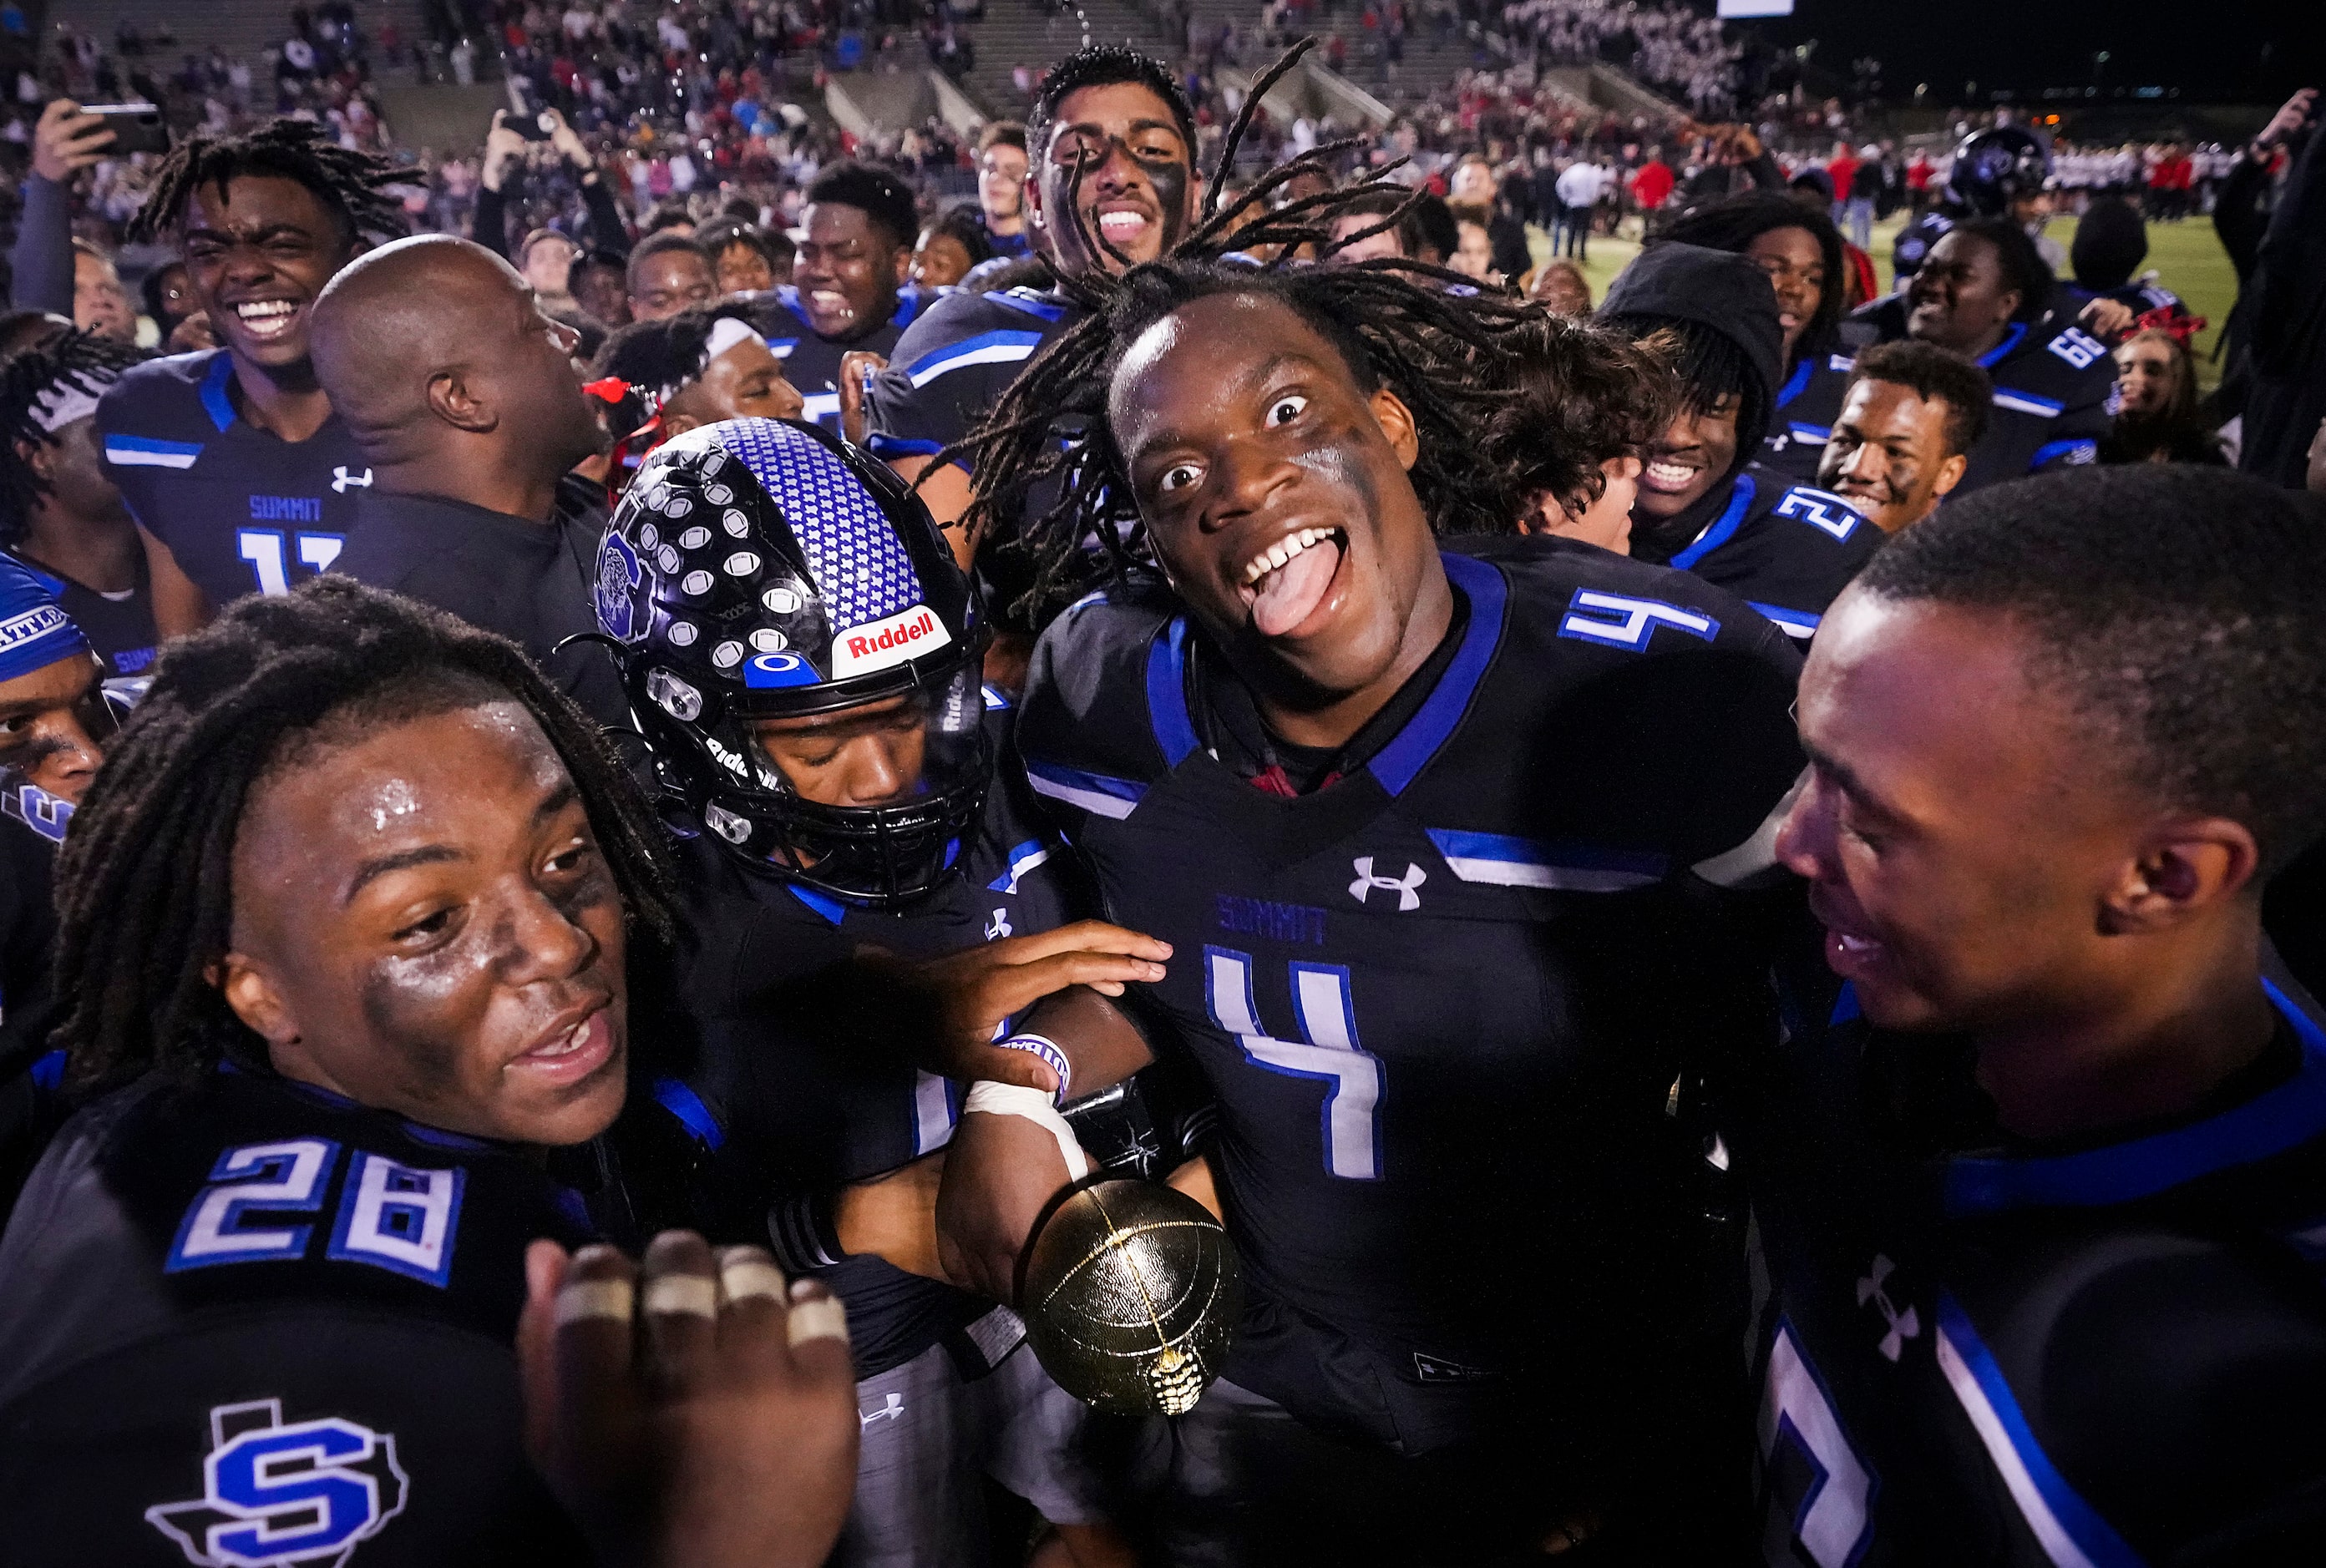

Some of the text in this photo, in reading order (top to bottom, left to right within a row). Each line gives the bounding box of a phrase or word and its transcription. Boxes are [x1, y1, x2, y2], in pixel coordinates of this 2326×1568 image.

[249, 494, 322, 522] SUMMIT
[846, 612, 935, 660] Riddell
[1556, 586, 1721, 655] 4
[1214, 892, 1328, 946] SUMMIT
[1202, 943, 1388, 1183] 4
[163, 1135, 469, 1290] 28
[203, 1417, 380, 1567] S
